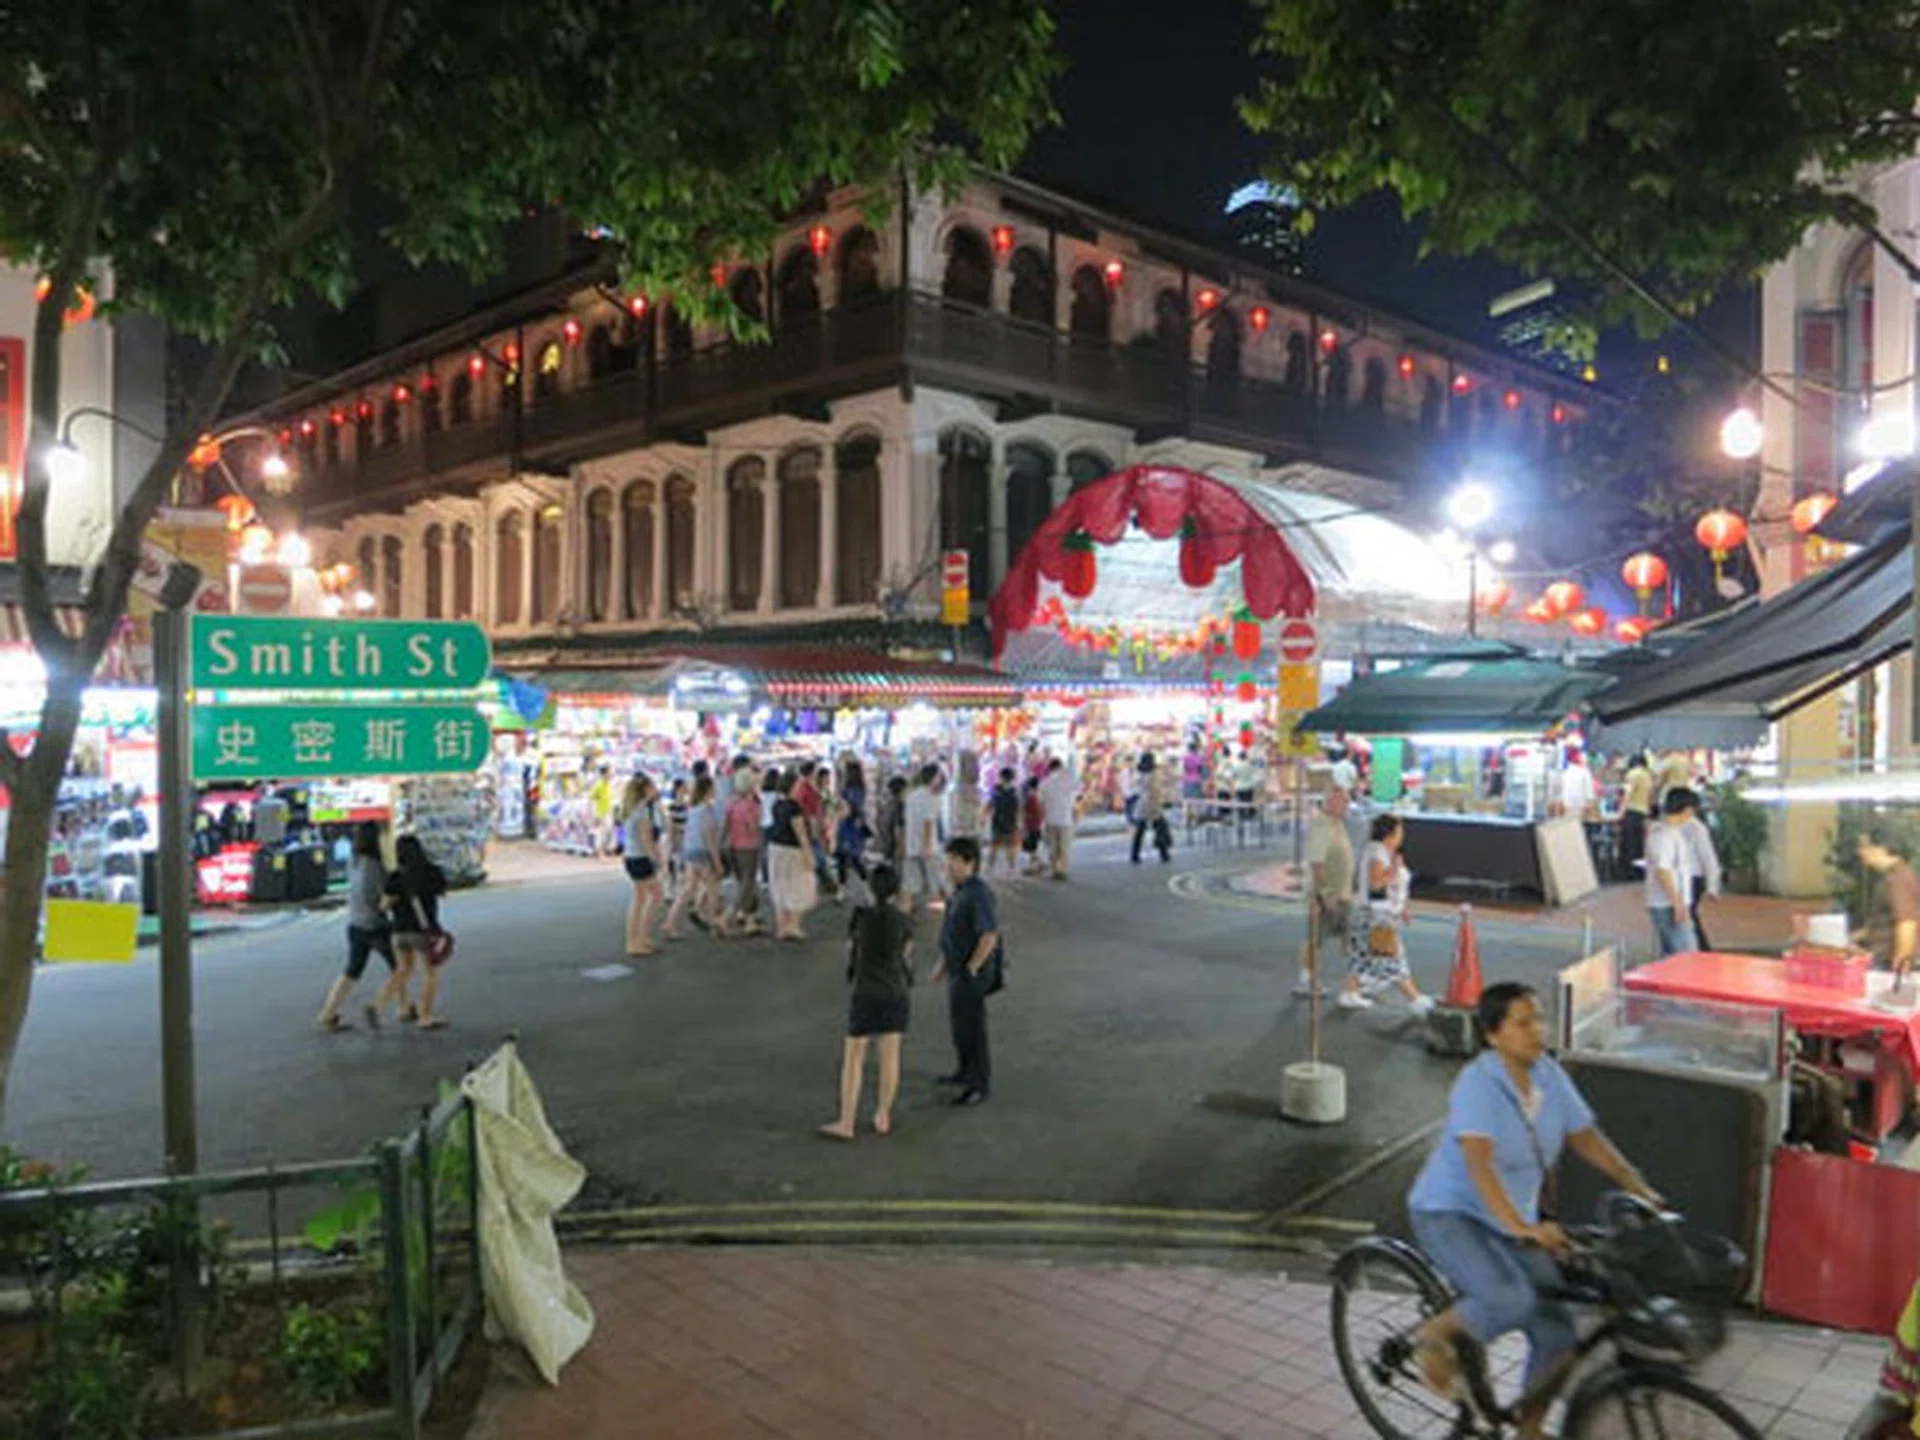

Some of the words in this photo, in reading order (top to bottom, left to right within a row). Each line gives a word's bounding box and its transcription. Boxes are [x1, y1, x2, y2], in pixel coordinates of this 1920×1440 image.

[209, 630, 381, 676] Smith
[409, 634, 458, 677] St
[216, 719, 474, 765] 史密斯街
